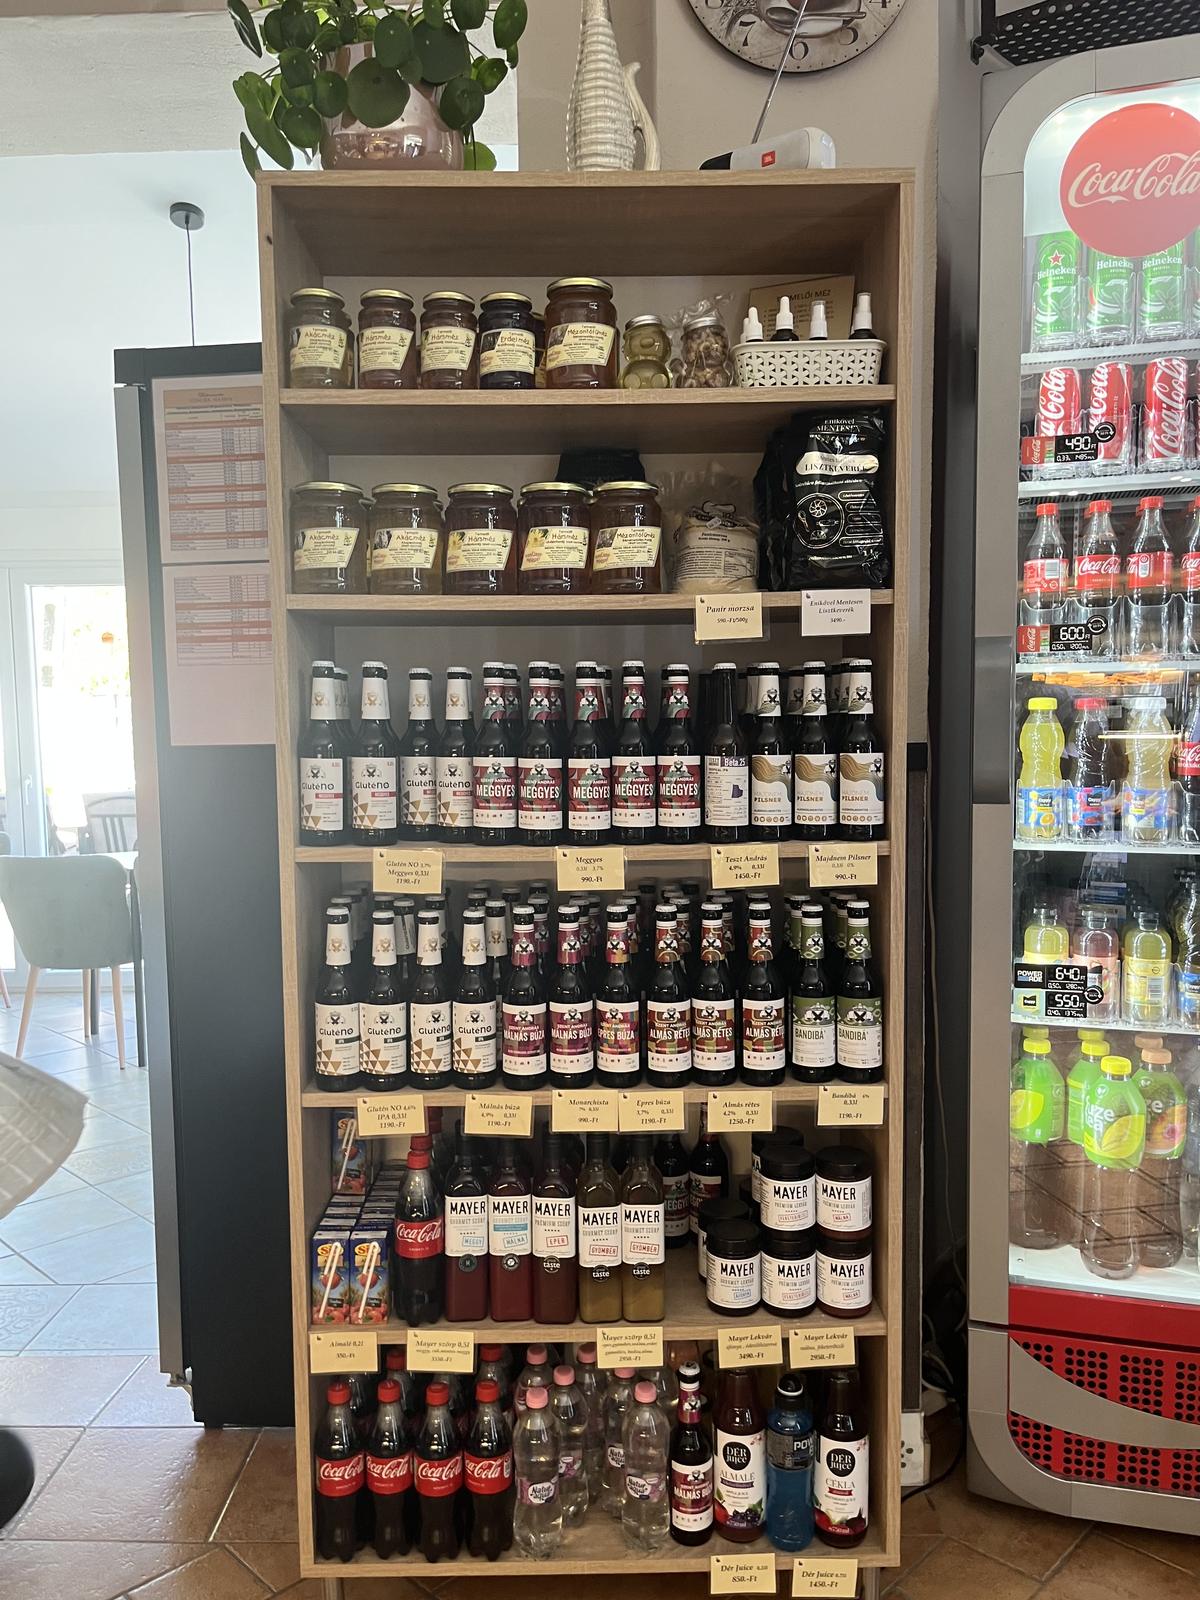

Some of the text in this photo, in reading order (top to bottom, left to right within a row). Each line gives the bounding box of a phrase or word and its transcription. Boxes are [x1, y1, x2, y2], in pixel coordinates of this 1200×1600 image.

[739, 20, 757, 47] 7
[1142, 254, 1183, 272] Heineken
[1065, 436, 1091, 450] 490
[1079, 557, 1120, 576] Coca-Cola
[1060, 626, 1085, 640] 600
[476, 784, 515, 798] MEGGYES
[521, 785, 561, 799] MEGGYES
[573, 786, 611, 799] MEGGYES
[615, 784, 653, 797] MEGGYES
[660, 783, 698, 796] MEGGYES
[725, 855, 743, 864] Teszt
[835, 873, 857, 881] 990.-Ft
[1017, 969, 1043, 977] POWER
[1055, 967, 1080, 981] 640
[1055, 994, 1079, 1008] 550
[617, 1029, 636, 1040] BÚZA
[650, 1028, 673, 1040] ALMÁS
[745, 1026, 769, 1038] ALMÁS
[390, 1103, 402, 1111] NO
[569, 1099, 609, 1108] Monarchista
[773, 1185, 809, 1201] MAYER
[821, 1183, 857, 1201] MAYER
[450, 1201, 486, 1215] MAYER
[492, 1200, 529, 1214] MAYER
[535, 1202, 571, 1217] MAYER
[582, 1211, 619, 1227] MAYER
[624, 1209, 660, 1224] MAYER
[396, 1220, 441, 1244] Coca-Cola
[592, 1270, 610, 1278] taste
[633, 1267, 651, 1275] taste
[720, 1262, 755, 1278] MAYER
[777, 1263, 812, 1278] MAYER
[830, 1263, 865, 1278] MAYER
[728, 1333, 774, 1344] Mayer Lekvár
[804, 1332, 849, 1343] Mayer Lekvár
[735, 1565, 754, 1574] Juice
[801, 1570, 834, 1579] Dér Juice
[809, 1581, 838, 1589] 1450.-Ft
